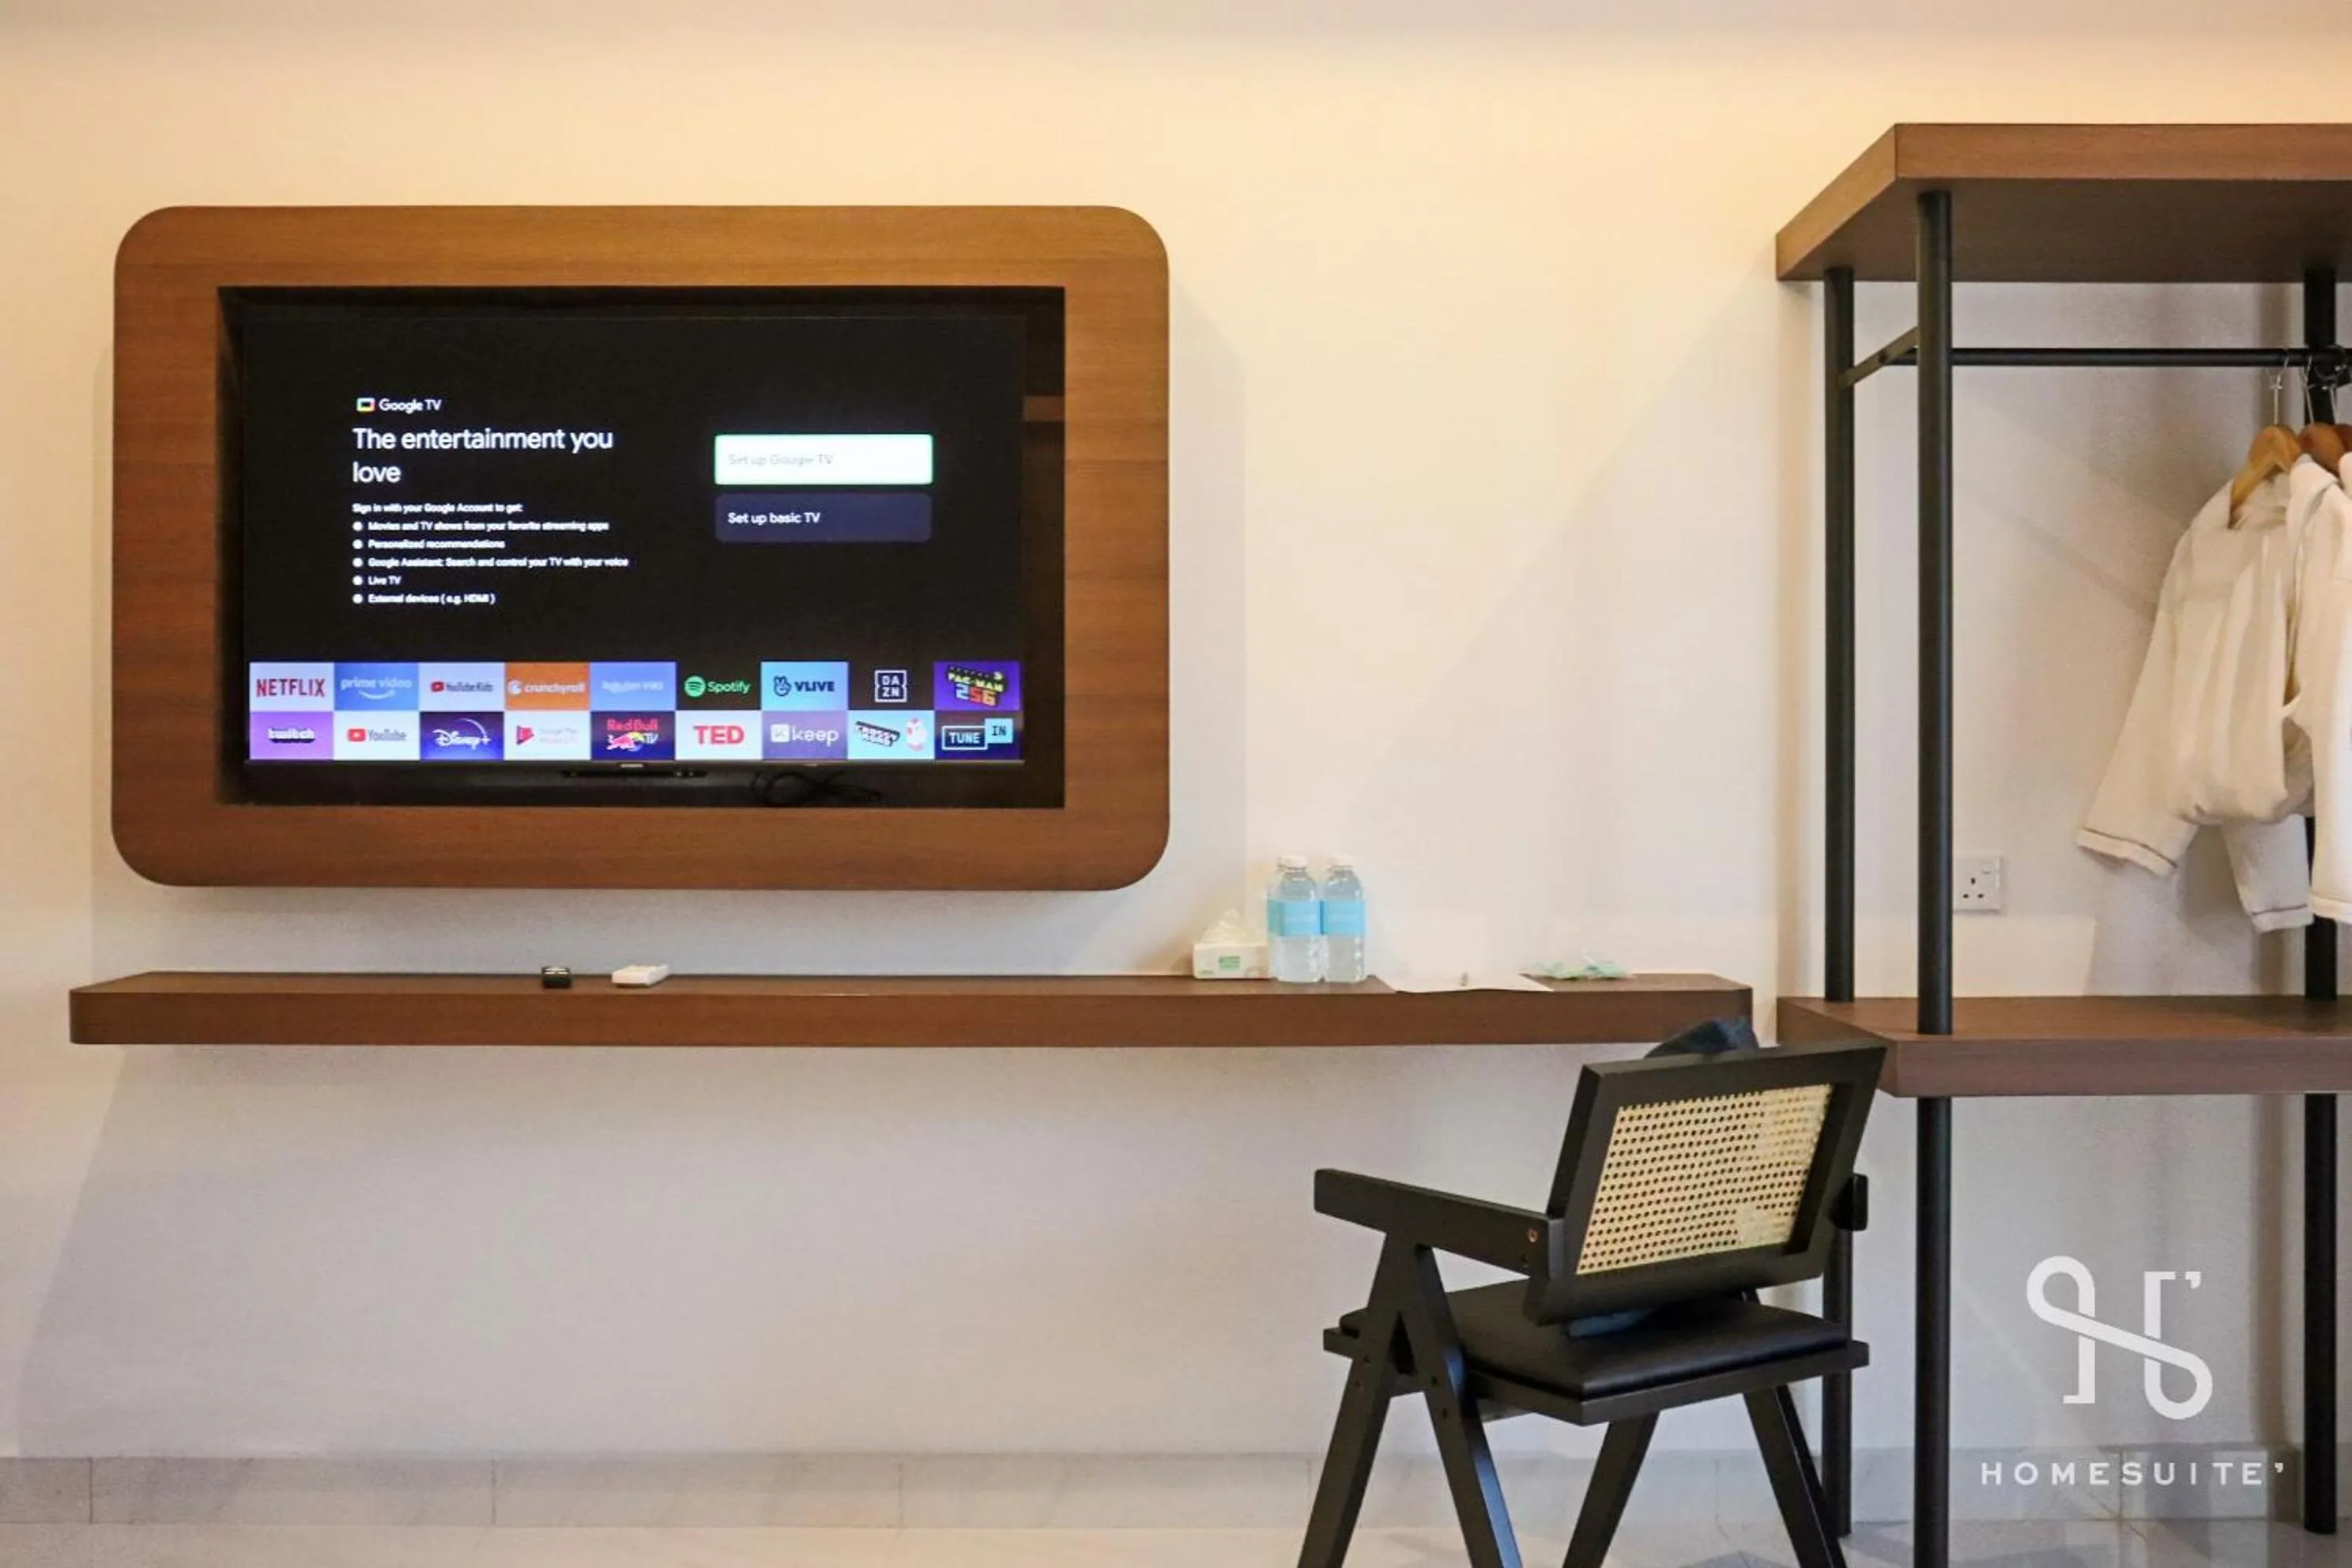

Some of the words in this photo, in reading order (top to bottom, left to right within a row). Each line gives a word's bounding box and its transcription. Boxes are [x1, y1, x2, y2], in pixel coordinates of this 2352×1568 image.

[379, 398, 423, 413] Google
[424, 399, 442, 411] TV
[352, 428, 396, 449] The
[401, 428, 565, 449] entertainment
[571, 432, 614, 454] you
[729, 454, 748, 465] Set
[752, 457, 767, 466] up
[816, 454, 834, 465] TV
[352, 461, 401, 483] love
[352, 503, 371, 514] Sign
[373, 503, 381, 512] in
[383, 503, 402, 512] with
[403, 505, 422, 514] your
[424, 503, 454, 514] Google
[457, 503, 493, 512] Account
[495, 503, 505, 512] to
[727, 512, 749, 523] Set
[751, 514, 767, 526] up
[769, 512, 801, 523] basic
[804, 512, 821, 523] TV
[368, 522, 400, 530] Movies
[401, 522, 419, 530] and
[420, 522, 433, 530] TV
[434, 522, 462, 530] shows
[464, 521, 484, 530] from
[486, 522, 506, 532] your
[587, 522, 609, 532] apps
[368, 557, 399, 568] Google
[446, 557, 477, 567] Search
[477, 557, 495, 567] and
[496, 557, 527, 567] control
[527, 559, 547, 568] your
[548, 557, 563, 567] TV
[563, 557, 582, 567] with
[583, 559, 603, 568] your
[604, 557, 629, 567] voice
[368, 575, 387, 585] Live
[388, 575, 402, 585] TV
[405, 594, 439, 603] devices
[256, 678, 326, 697] NETFLIX
[341, 677, 376, 690] prime
[378, 677, 413, 689] video
[524, 680, 586, 695] crunchyroll
[707, 680, 750, 694] Spotify
[793, 680, 835, 692] VLIVE
[955, 683, 997, 707] 256
[606, 718, 631, 732] Red
[632, 718, 659, 732] Bull
[991, 725, 1006, 736] IN
[368, 729, 408, 741] YouTube
[694, 725, 744, 744] TED
[791, 724, 839, 746] keep
[948, 731, 980, 744] TUNE
